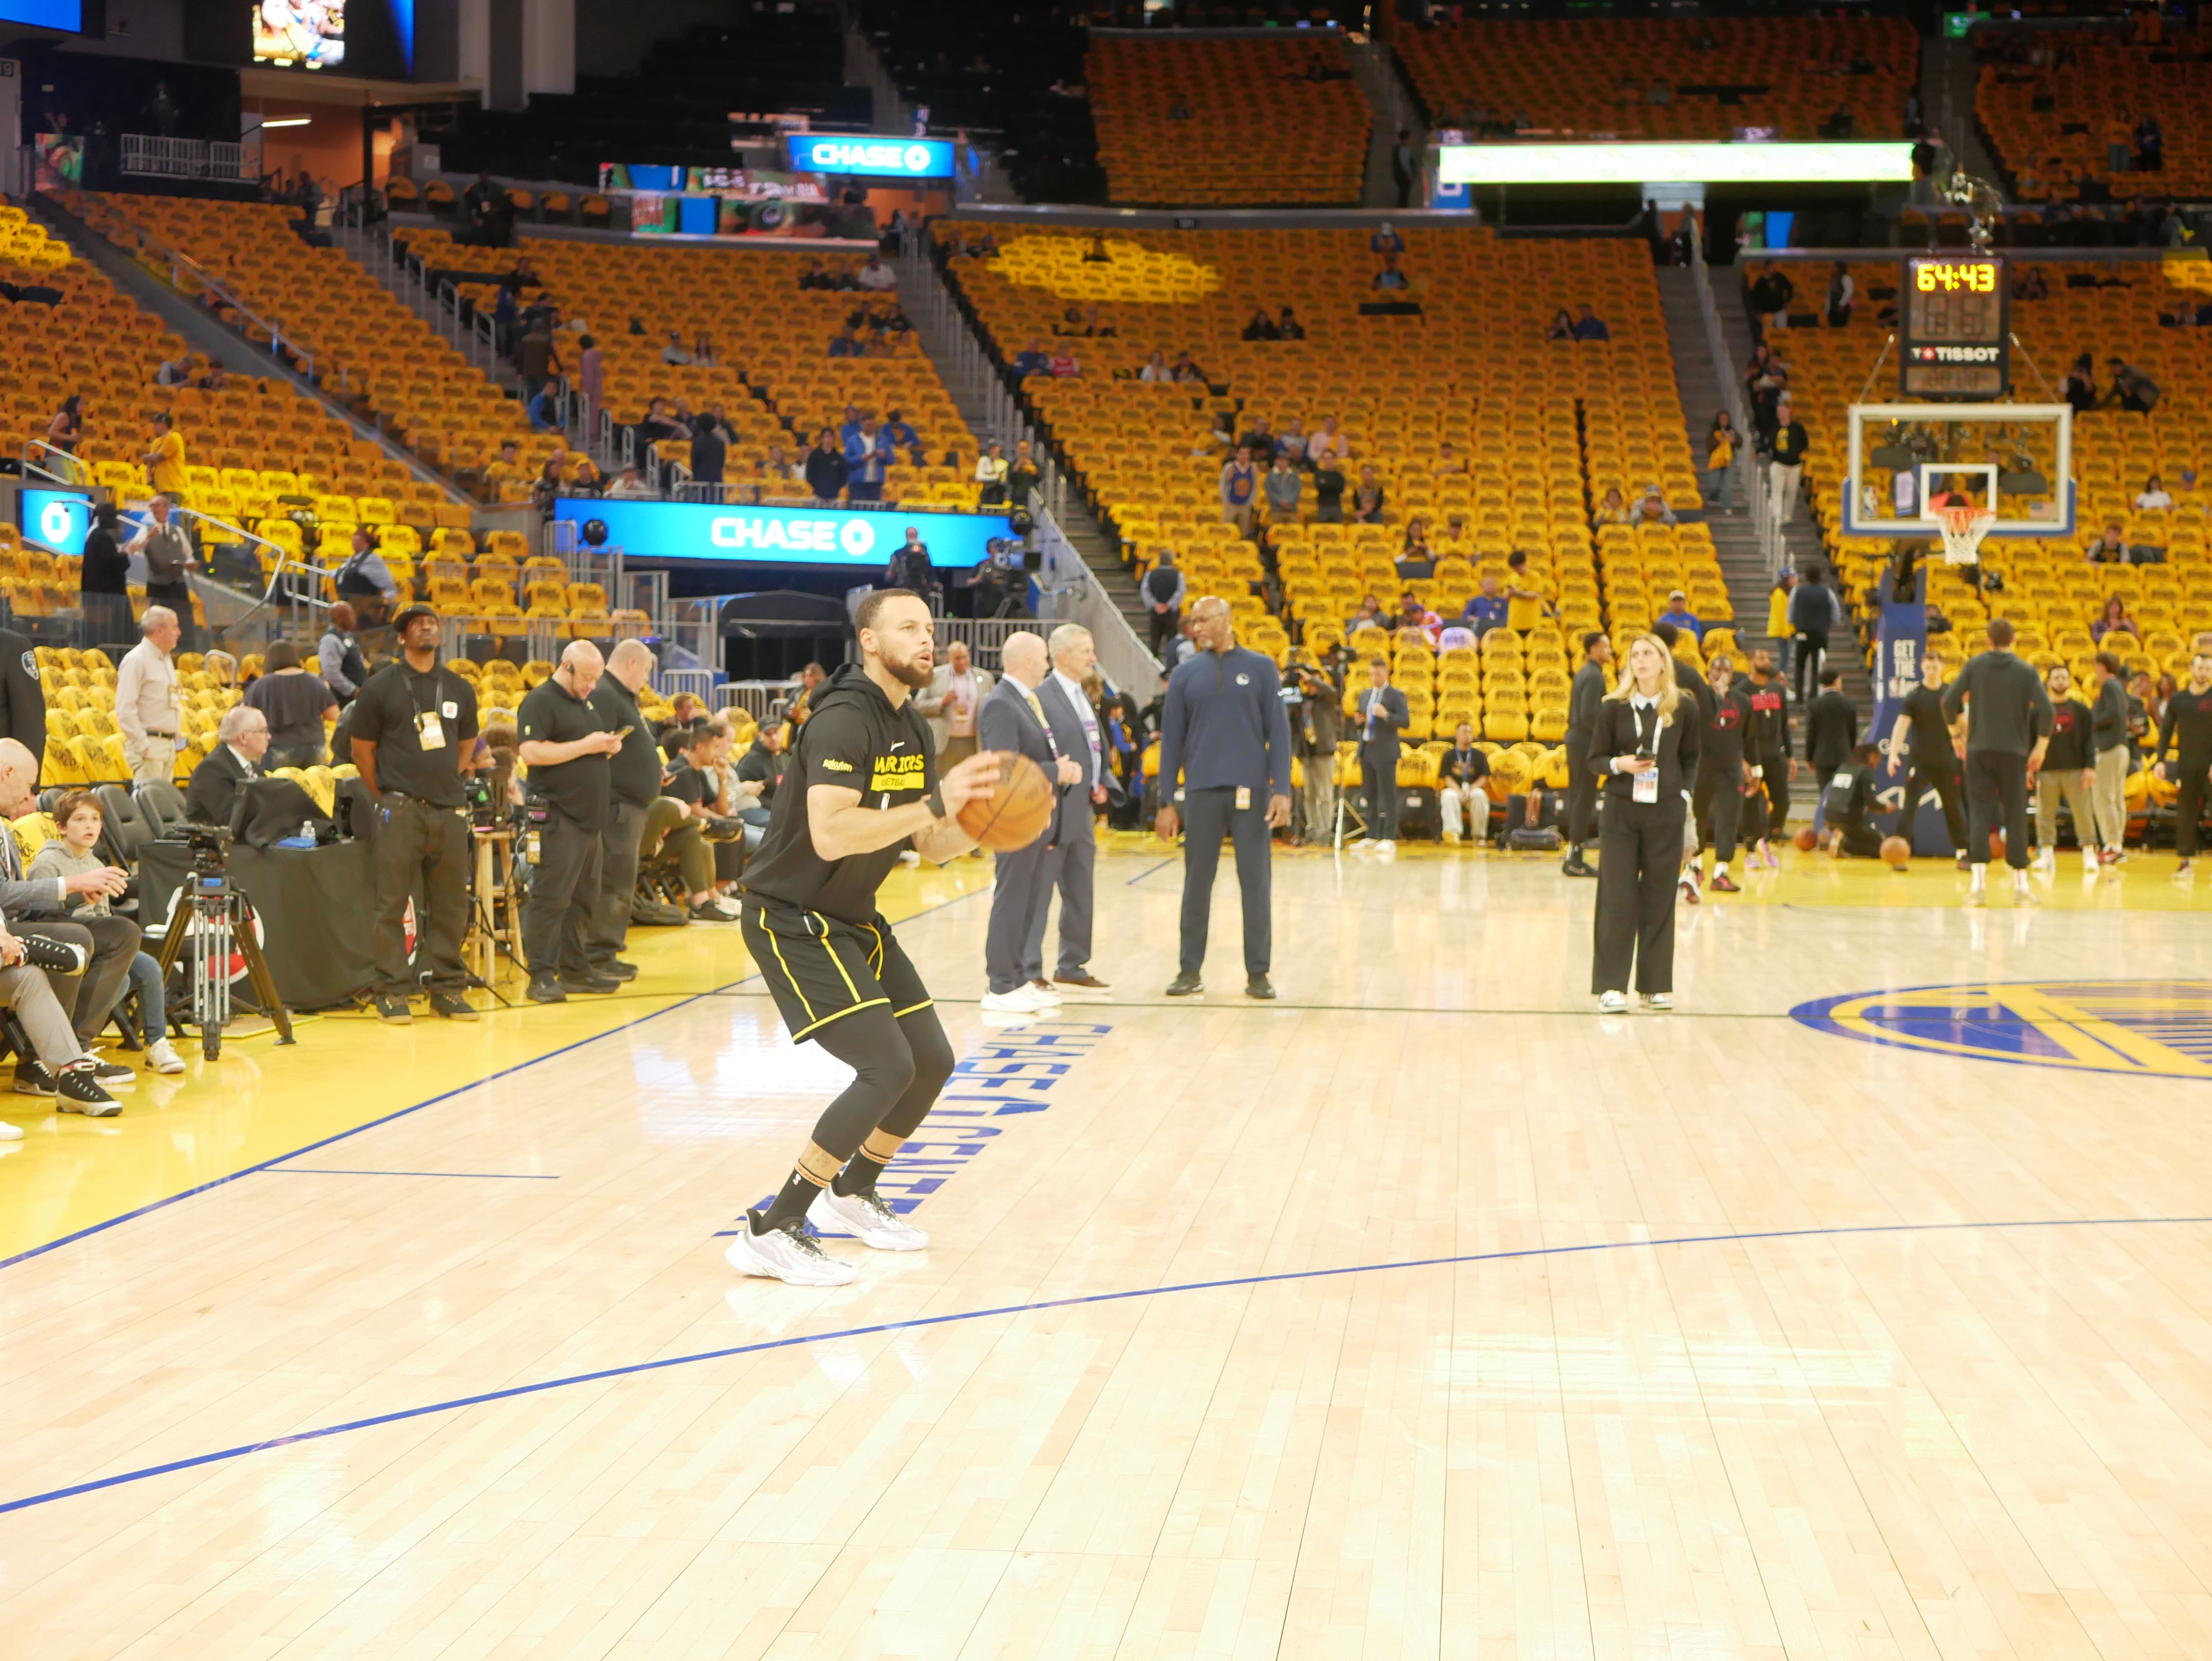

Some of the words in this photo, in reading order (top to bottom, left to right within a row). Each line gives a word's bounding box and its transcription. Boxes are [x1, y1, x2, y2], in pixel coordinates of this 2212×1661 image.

[813, 144, 904, 168] CHASE
[1917, 264, 1995, 291] 64:43
[1936, 346, 1999, 361] TISSOT
[711, 517, 837, 551] CHASE
[823, 759, 853, 773] Rakuten
[944, 1022, 1114, 1090] CHASE
